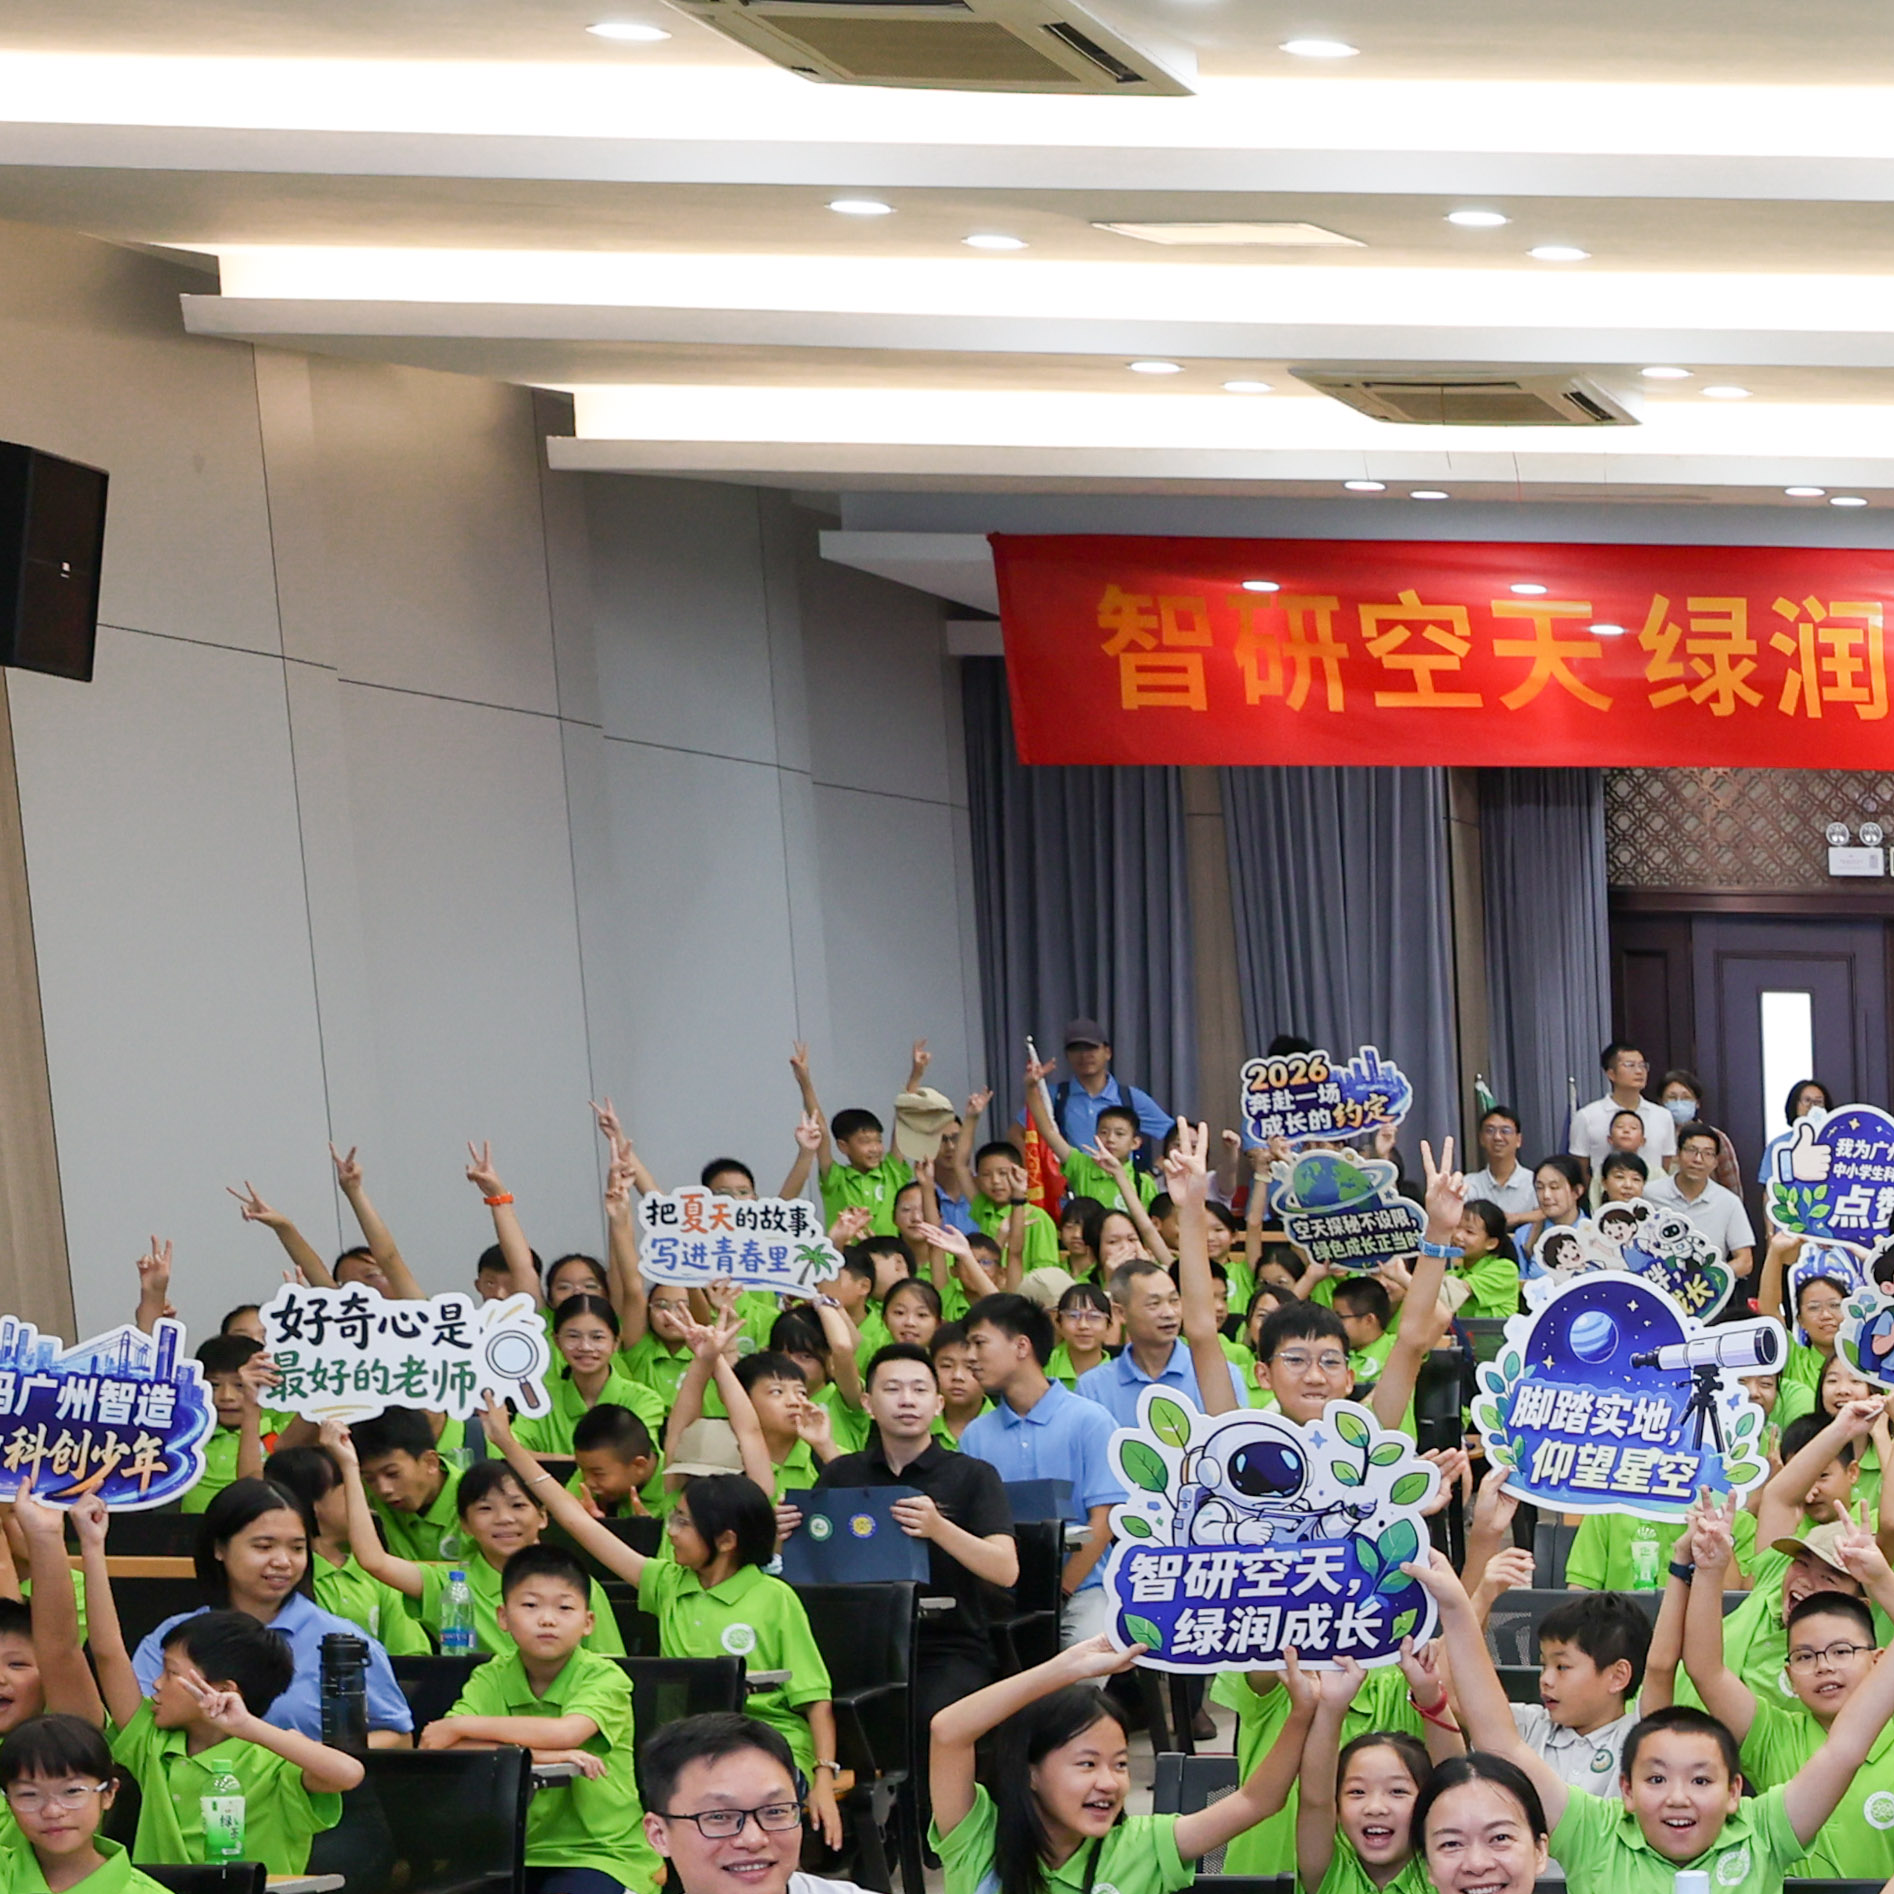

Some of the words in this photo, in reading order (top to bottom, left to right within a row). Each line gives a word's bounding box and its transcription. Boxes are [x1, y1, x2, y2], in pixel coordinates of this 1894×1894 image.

[1246, 1057, 1329, 1091] 2026
[1248, 1083, 1341, 1114] 奔赴一场
[1260, 1093, 1397, 1137] 成长的约定
[643, 1193, 816, 1239] 把夏天的故事，
[1293, 1207, 1417, 1241] 空天探秘不设限，
[649, 1237, 790, 1275] 写进青春里
[1311, 1231, 1422, 1260] 绿色成长正当时
[270, 1292, 473, 1350] 好奇心是
[265, 1350, 477, 1411] 最好的老师
[1508, 1384, 1682, 1446] 脚踏实地，
[0, 1423, 168, 1497] 科创少年
[1530, 1437, 1700, 1498] 仰望星空
[1127, 1546, 1362, 1603] 智研空天，
[1170, 1602, 1384, 1657] 绿润成长
